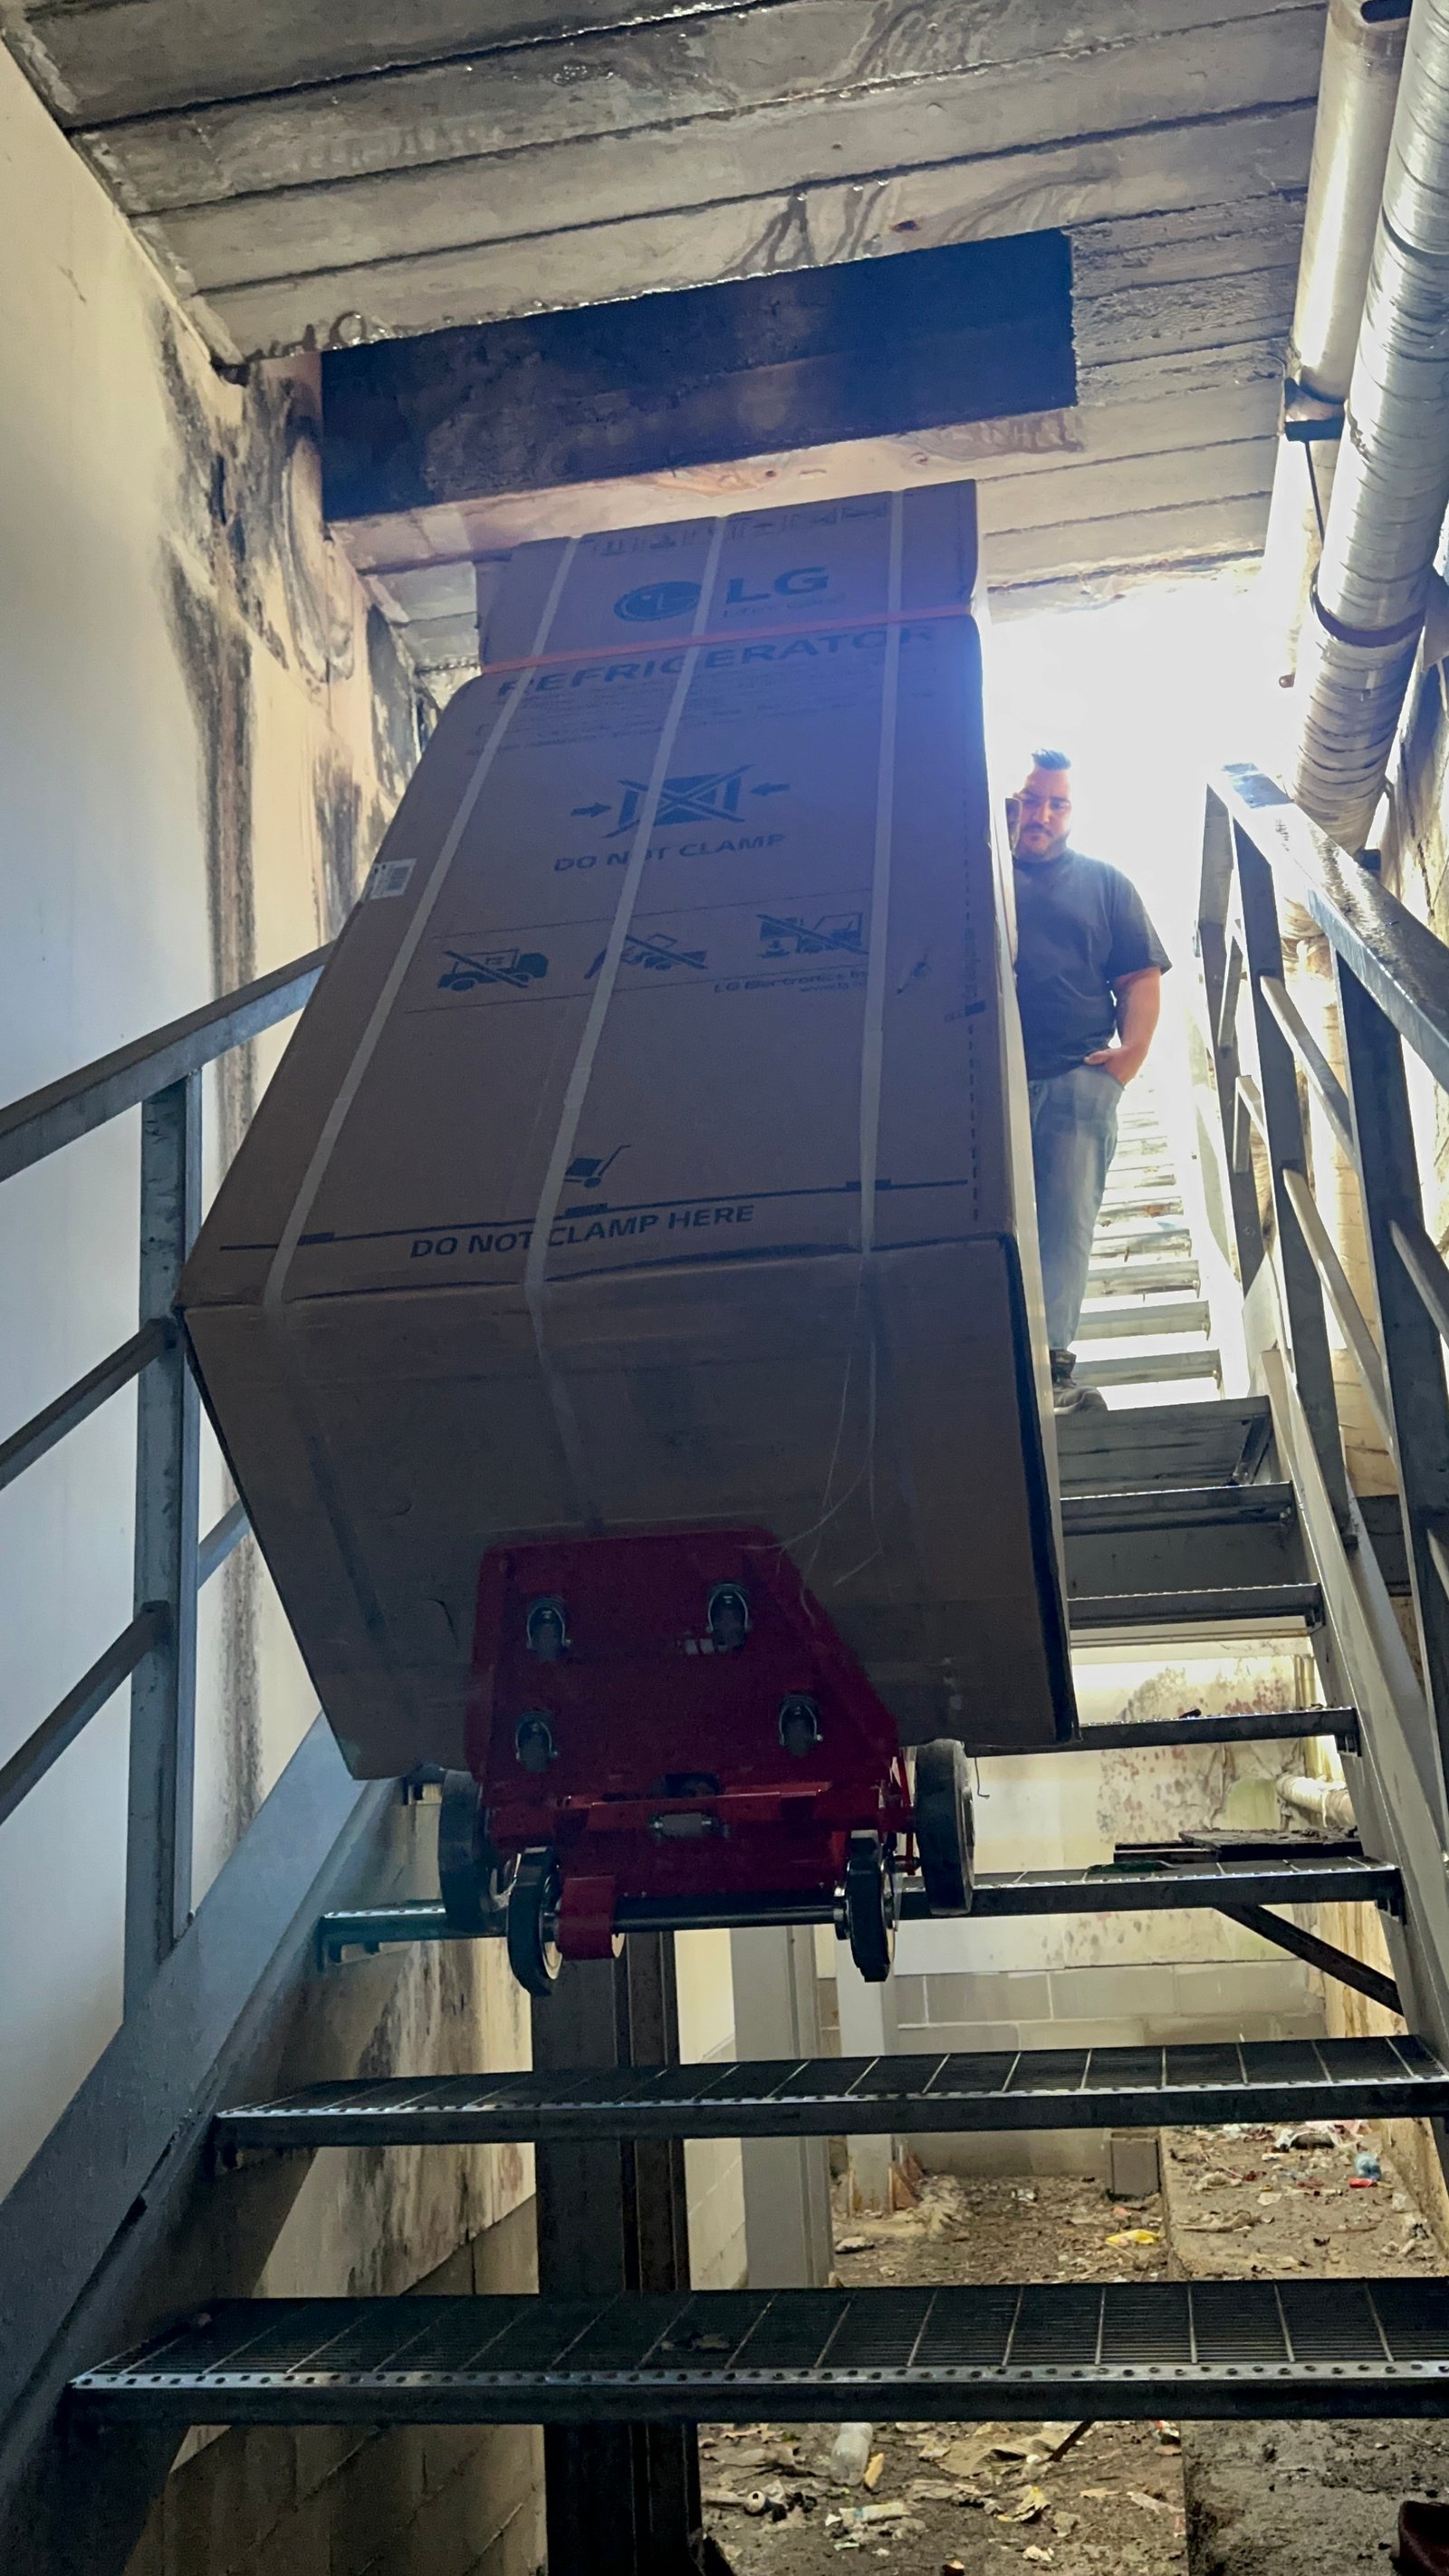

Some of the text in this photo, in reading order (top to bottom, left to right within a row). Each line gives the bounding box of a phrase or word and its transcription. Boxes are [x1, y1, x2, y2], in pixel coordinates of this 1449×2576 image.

[724, 566, 830, 605] LG
[497, 626, 935, 697] REFRIGERATOR
[553, 833, 786, 872] DO NT CLAMP
[410, 1204, 755, 1258] DO NOT CLAMP HERE
